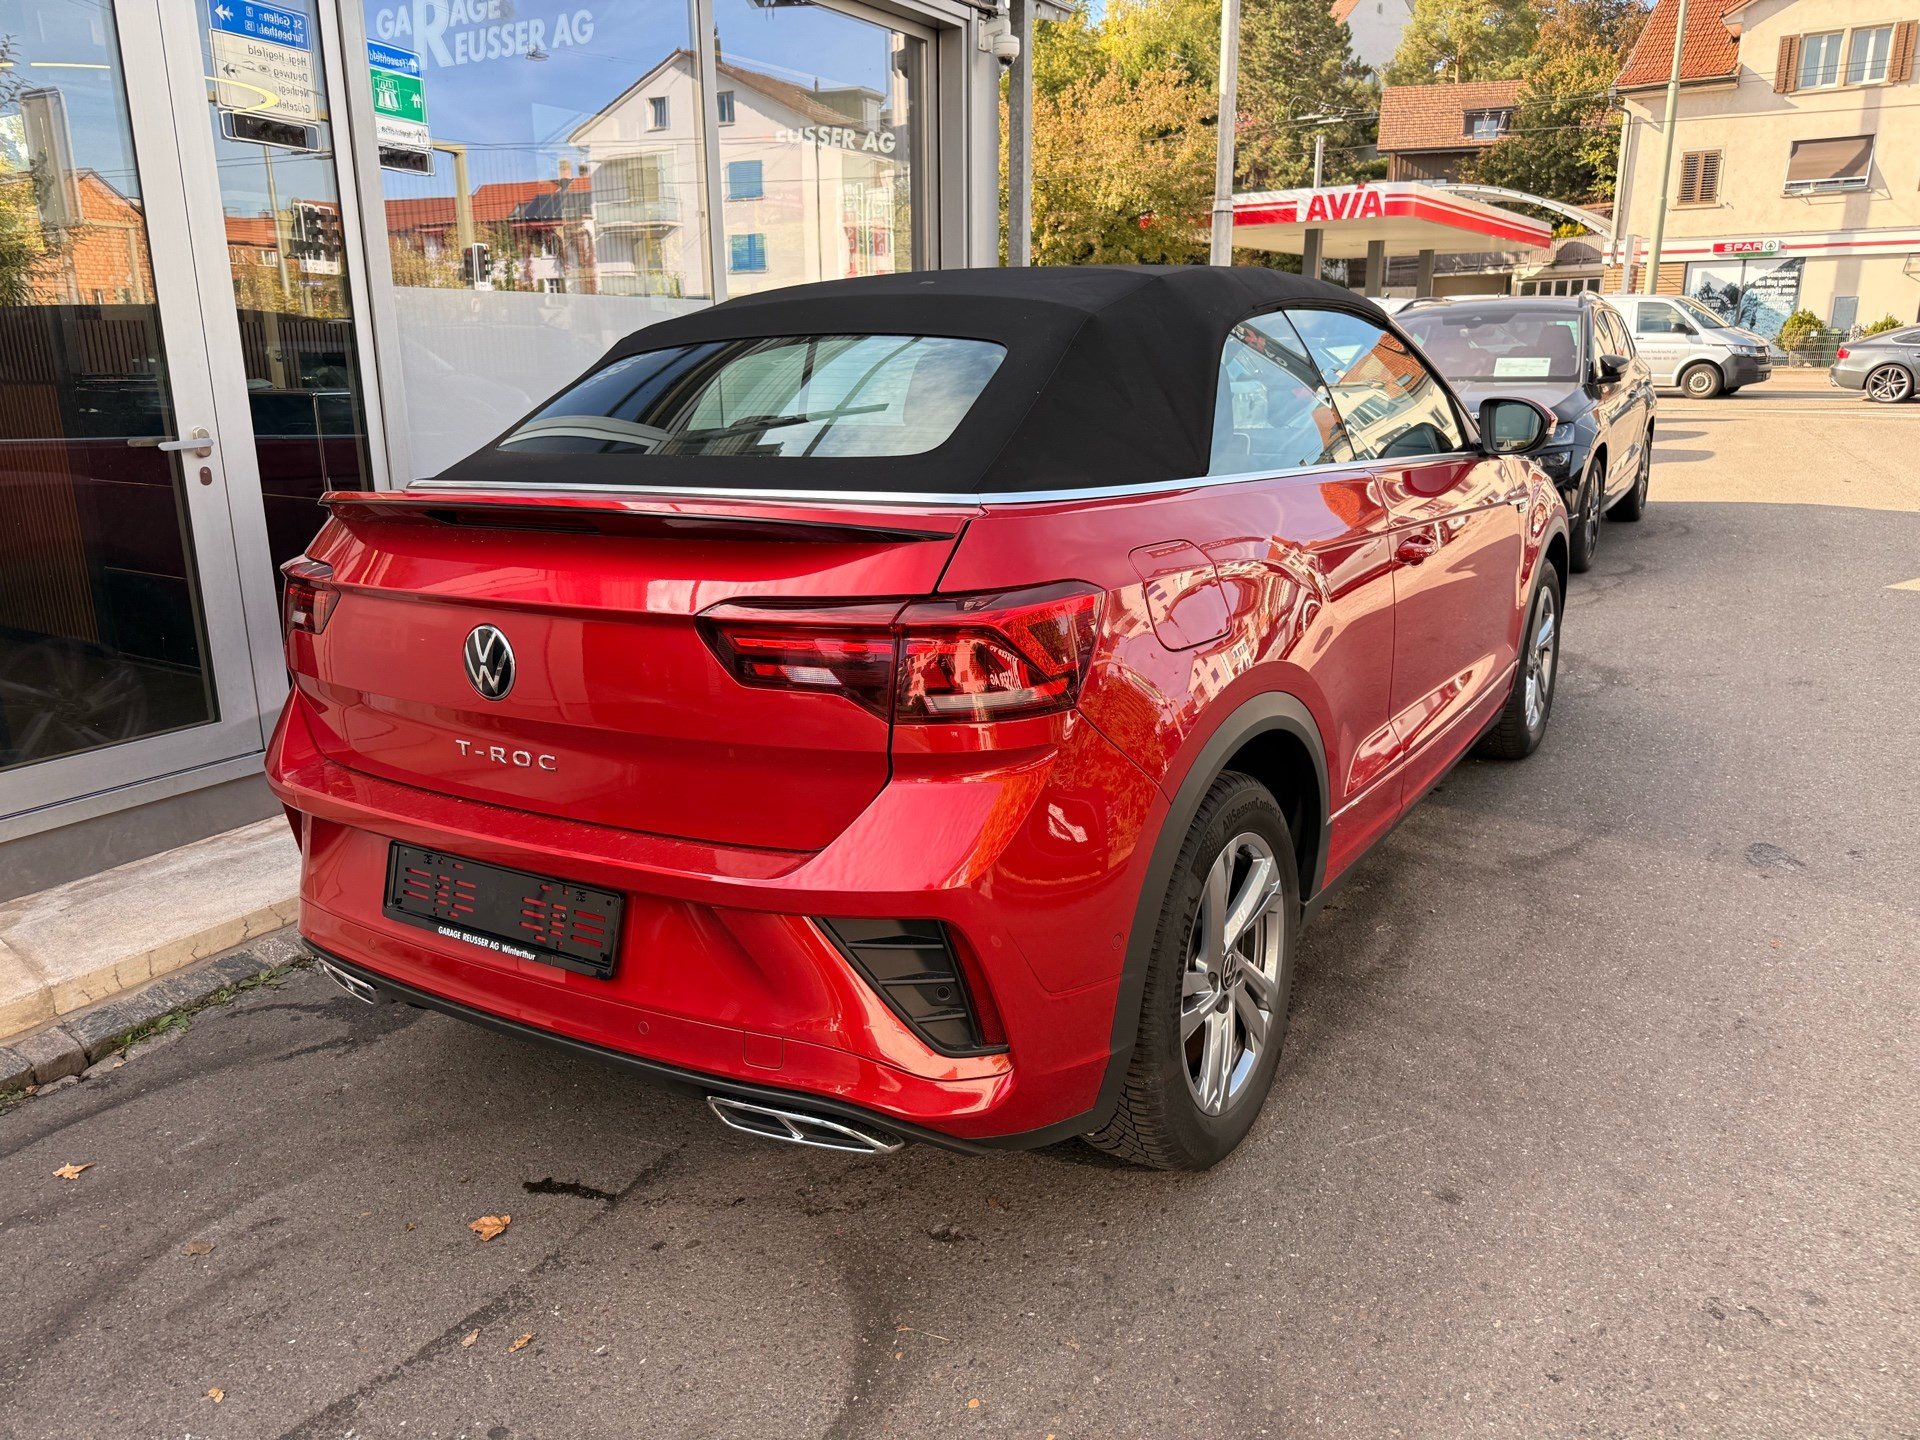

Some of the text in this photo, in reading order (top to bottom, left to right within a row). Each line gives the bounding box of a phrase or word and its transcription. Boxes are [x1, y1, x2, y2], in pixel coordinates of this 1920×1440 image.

[552, 9, 595, 49] AG
[861, 130, 896, 154] AG
[1304, 183, 1385, 222] AVIA
[1723, 242, 1763, 252] SPAR
[455, 739, 557, 772] T-ROC
[437, 925, 536, 961] GARAGE REUSSER AG Winterthur
